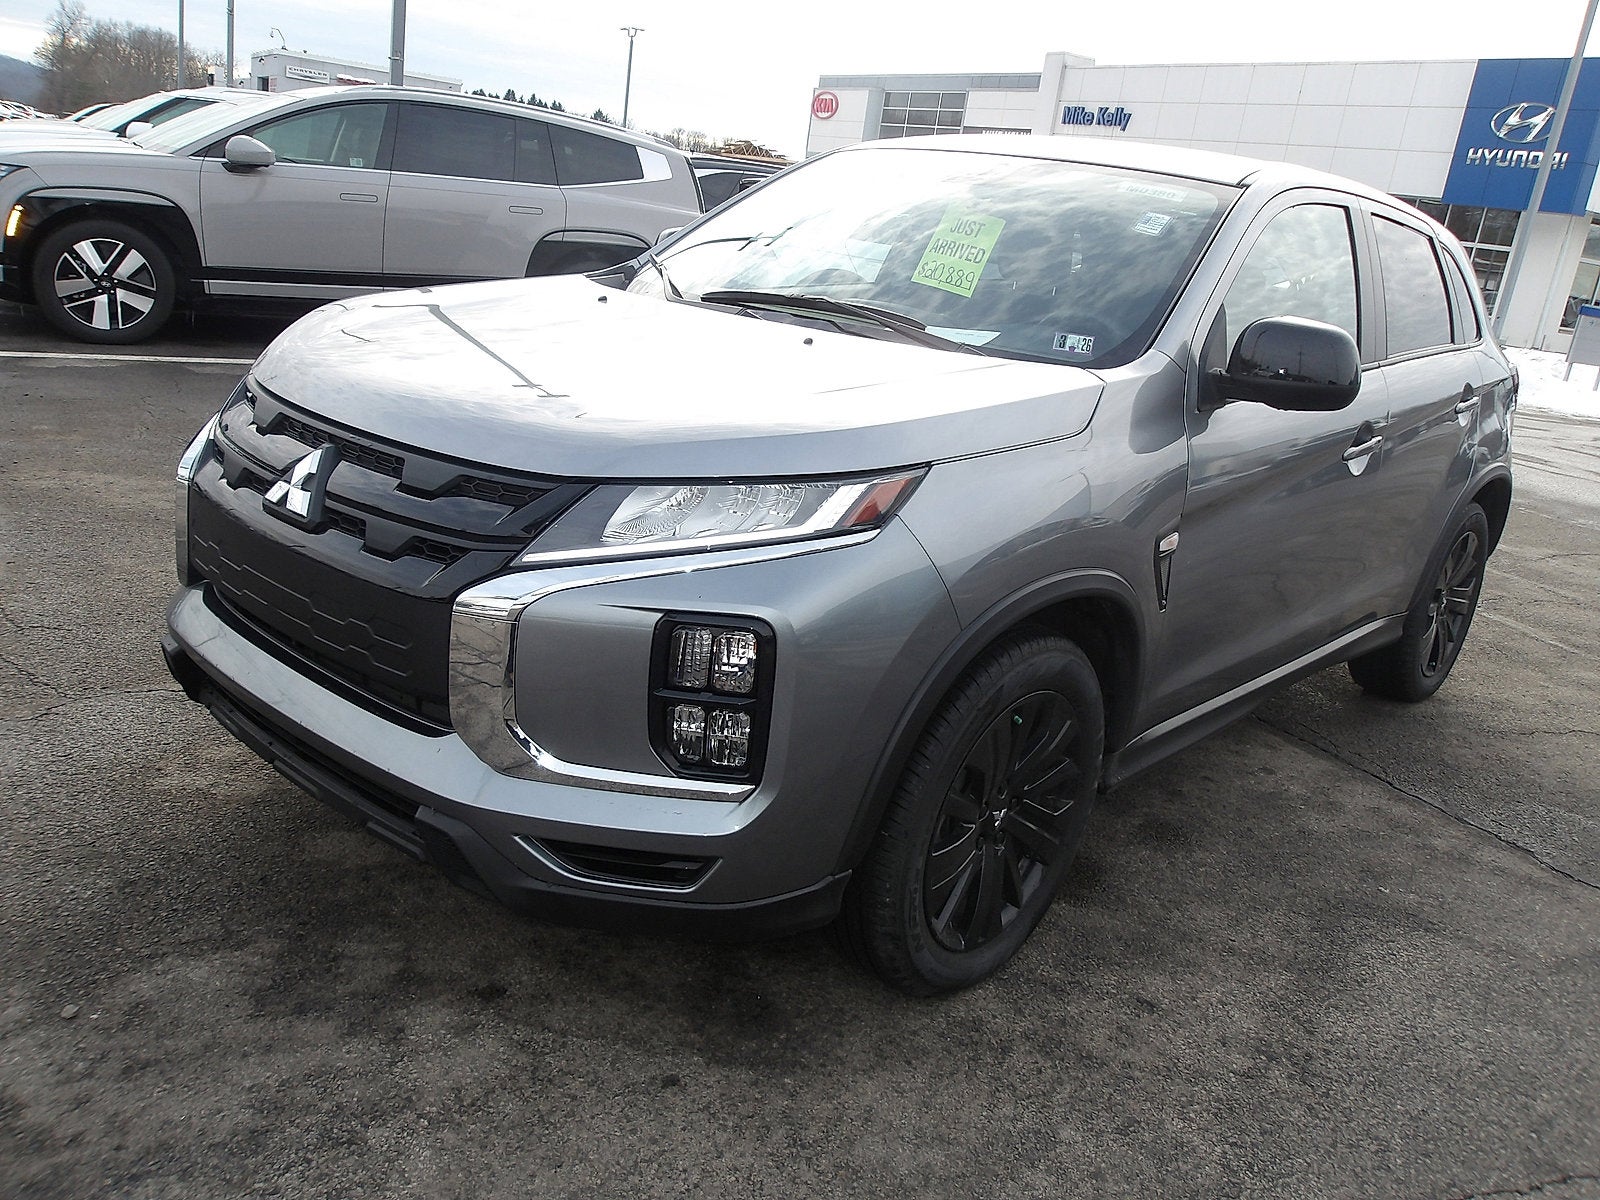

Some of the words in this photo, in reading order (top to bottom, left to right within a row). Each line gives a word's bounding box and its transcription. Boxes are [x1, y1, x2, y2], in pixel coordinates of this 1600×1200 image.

[288, 67, 328, 77] CHRYSLER
[1061, 105, 1094, 126] Mike
[1095, 106, 1132, 132] Kelly
[949, 217, 986, 239] JUST
[928, 238, 986, 264] ARRIVED
[917, 260, 976, 291] $20,889
[1059, 334, 1067, 349] 3
[1080, 337, 1092, 353] 26
